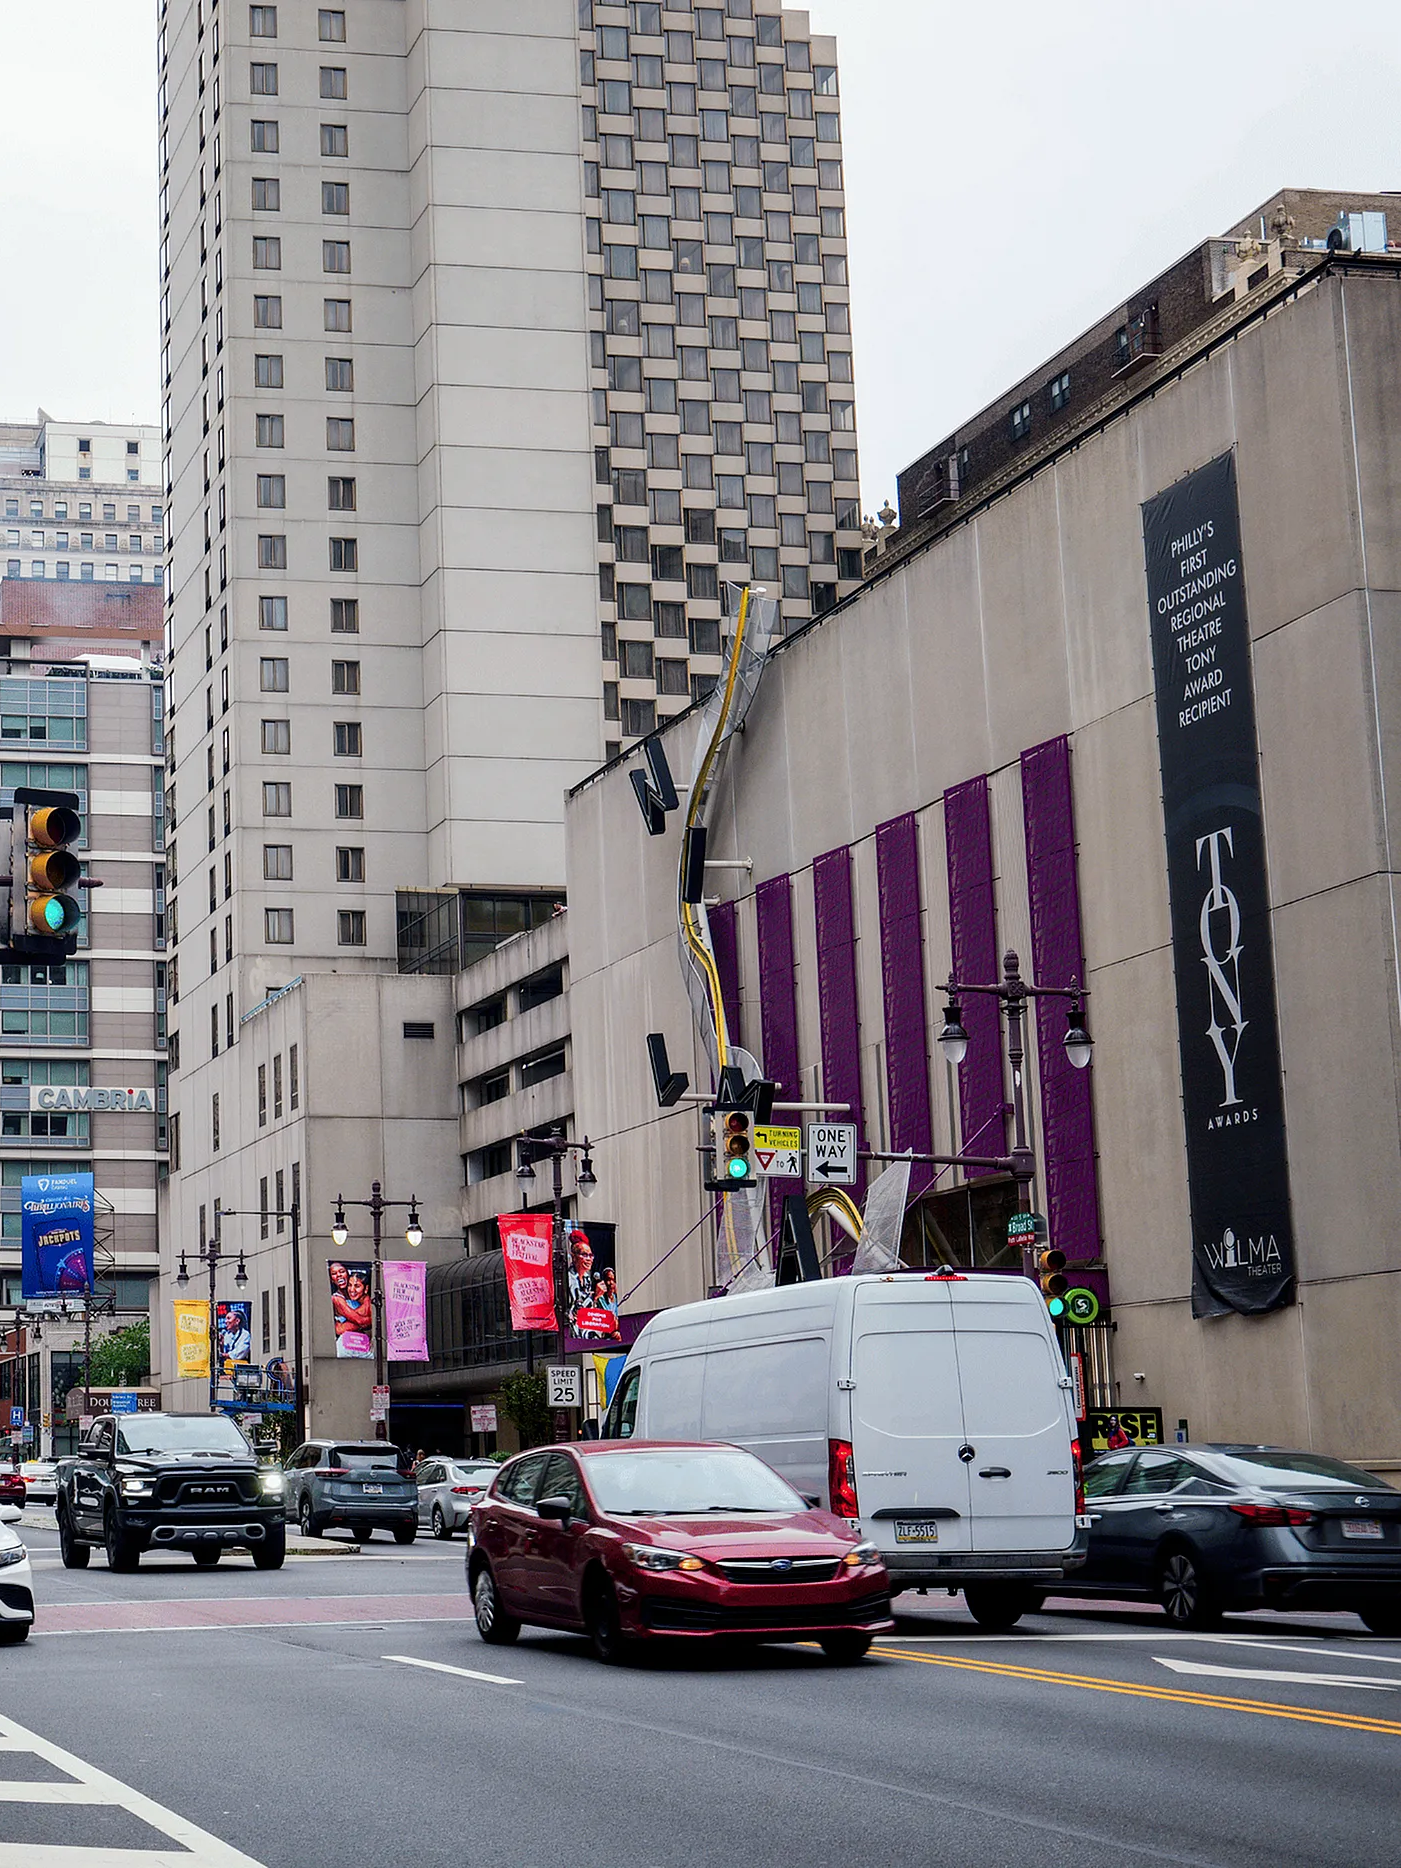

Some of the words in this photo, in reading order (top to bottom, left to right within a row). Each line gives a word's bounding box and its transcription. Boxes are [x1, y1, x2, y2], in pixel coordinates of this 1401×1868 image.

[1171, 520, 1214, 558] PHILLY'S
[1180, 549, 1208, 578] FIRST
[1157, 559, 1237, 614] OUTSTANDING
[1170, 591, 1226, 632] REGIONAL
[1177, 617, 1222, 653] THEATRE
[1185, 645, 1217, 674] TONY
[1183, 668, 1223, 701] AWARD
[1178, 689, 1232, 728] RECIPIENT
[1195, 826, 1250, 1108] TONY
[1207, 1108, 1259, 1131] AWARDS
[769, 1130, 798, 1139] TURNING
[769, 1140, 798, 1148] VEHICLES
[817, 1129, 846, 1143] ONE
[815, 1145, 847, 1158] WAY
[776, 1160, 784, 1168] TO
[1012, 1220, 1027, 1234] Broad
[38, 1229, 81, 1248] JACKPOTS
[1248, 1264, 1282, 1277] THEATER
[551, 1370, 576, 1378] SPEED
[553, 1387, 575, 1402] 25
[13, 1411, 21, 1419] H
[1092, 1413, 1157, 1439] RSE
